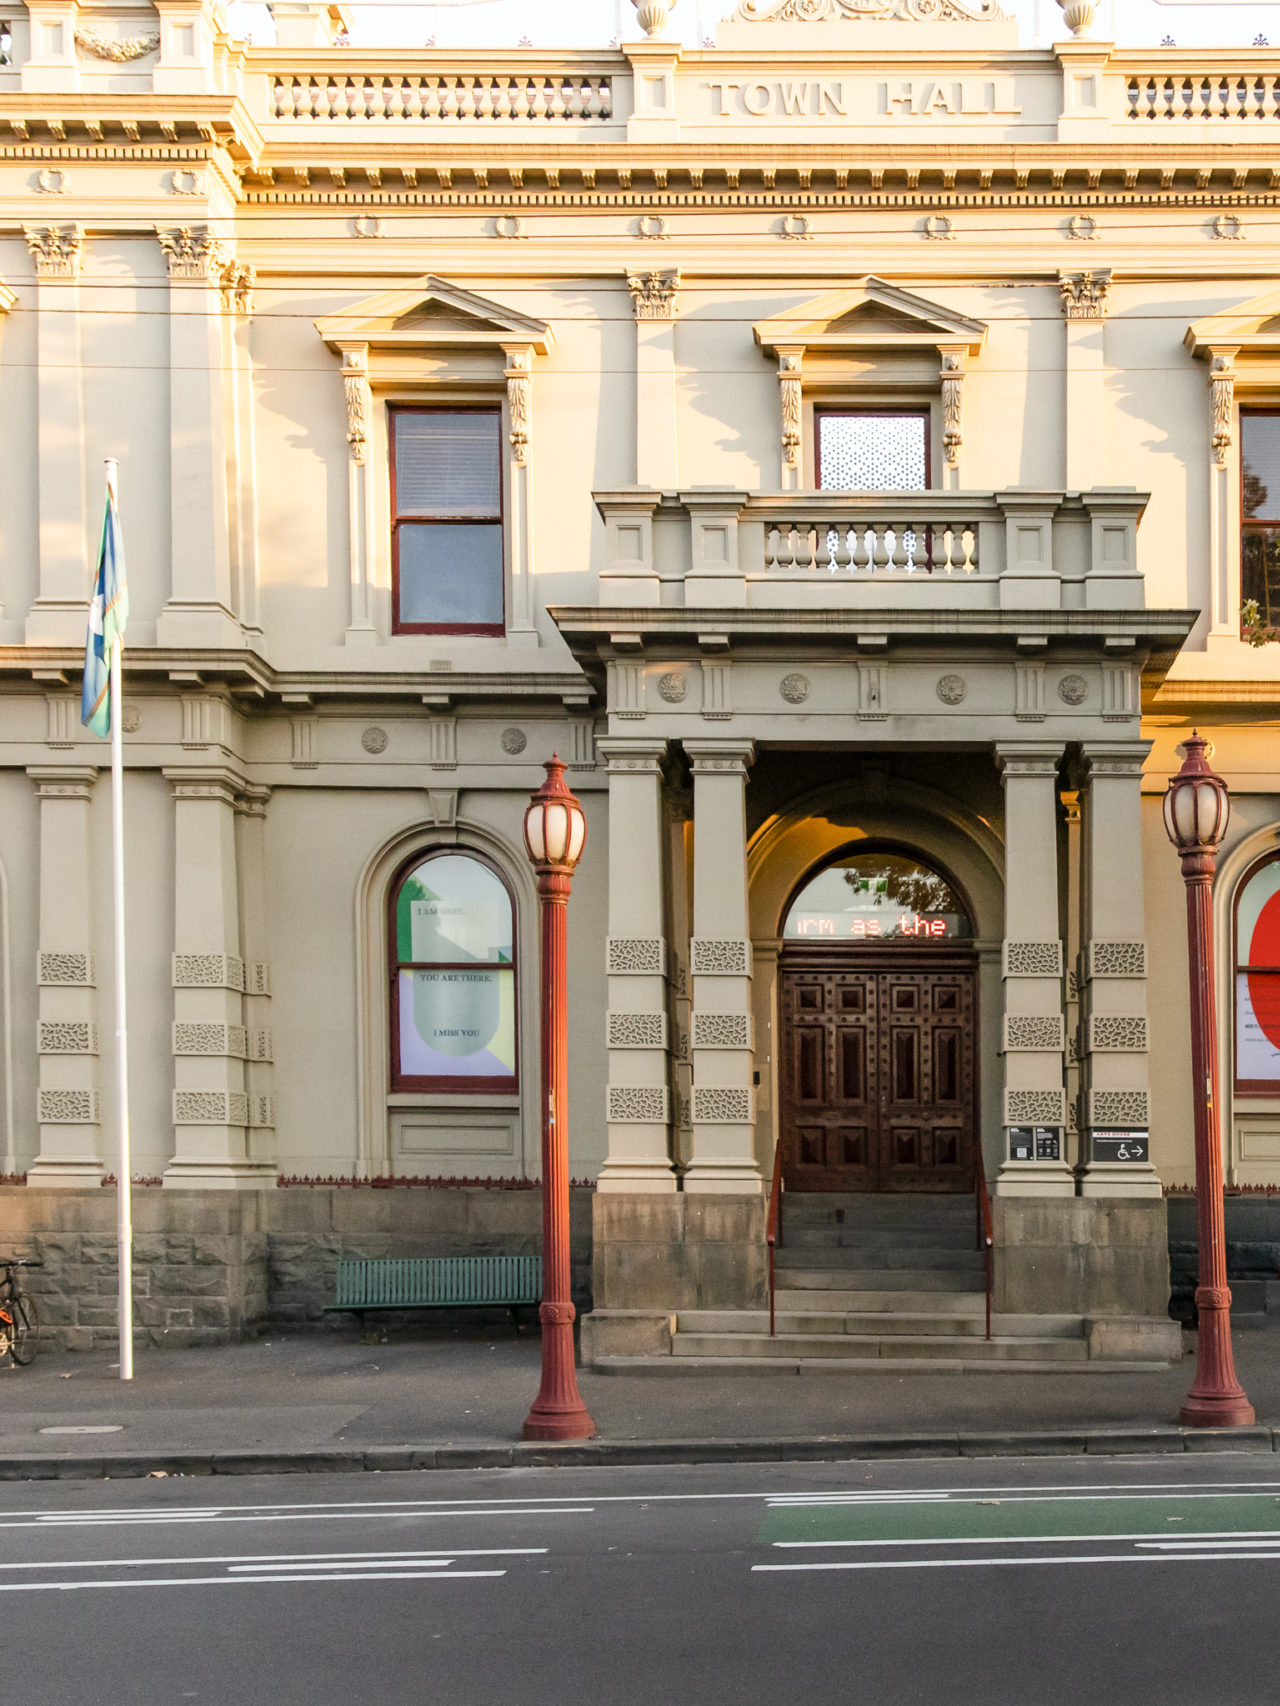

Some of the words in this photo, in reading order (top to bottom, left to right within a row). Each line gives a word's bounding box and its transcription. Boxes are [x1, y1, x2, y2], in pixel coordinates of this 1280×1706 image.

[703, 81, 848, 116] TOWN
[880, 81, 1022, 115] HALL
[851, 918, 882, 935] as
[899, 913, 946, 936] the
[420, 974, 440, 982] YOU
[441, 974, 459, 982] ARE
[460, 974, 492, 983] THERE,
